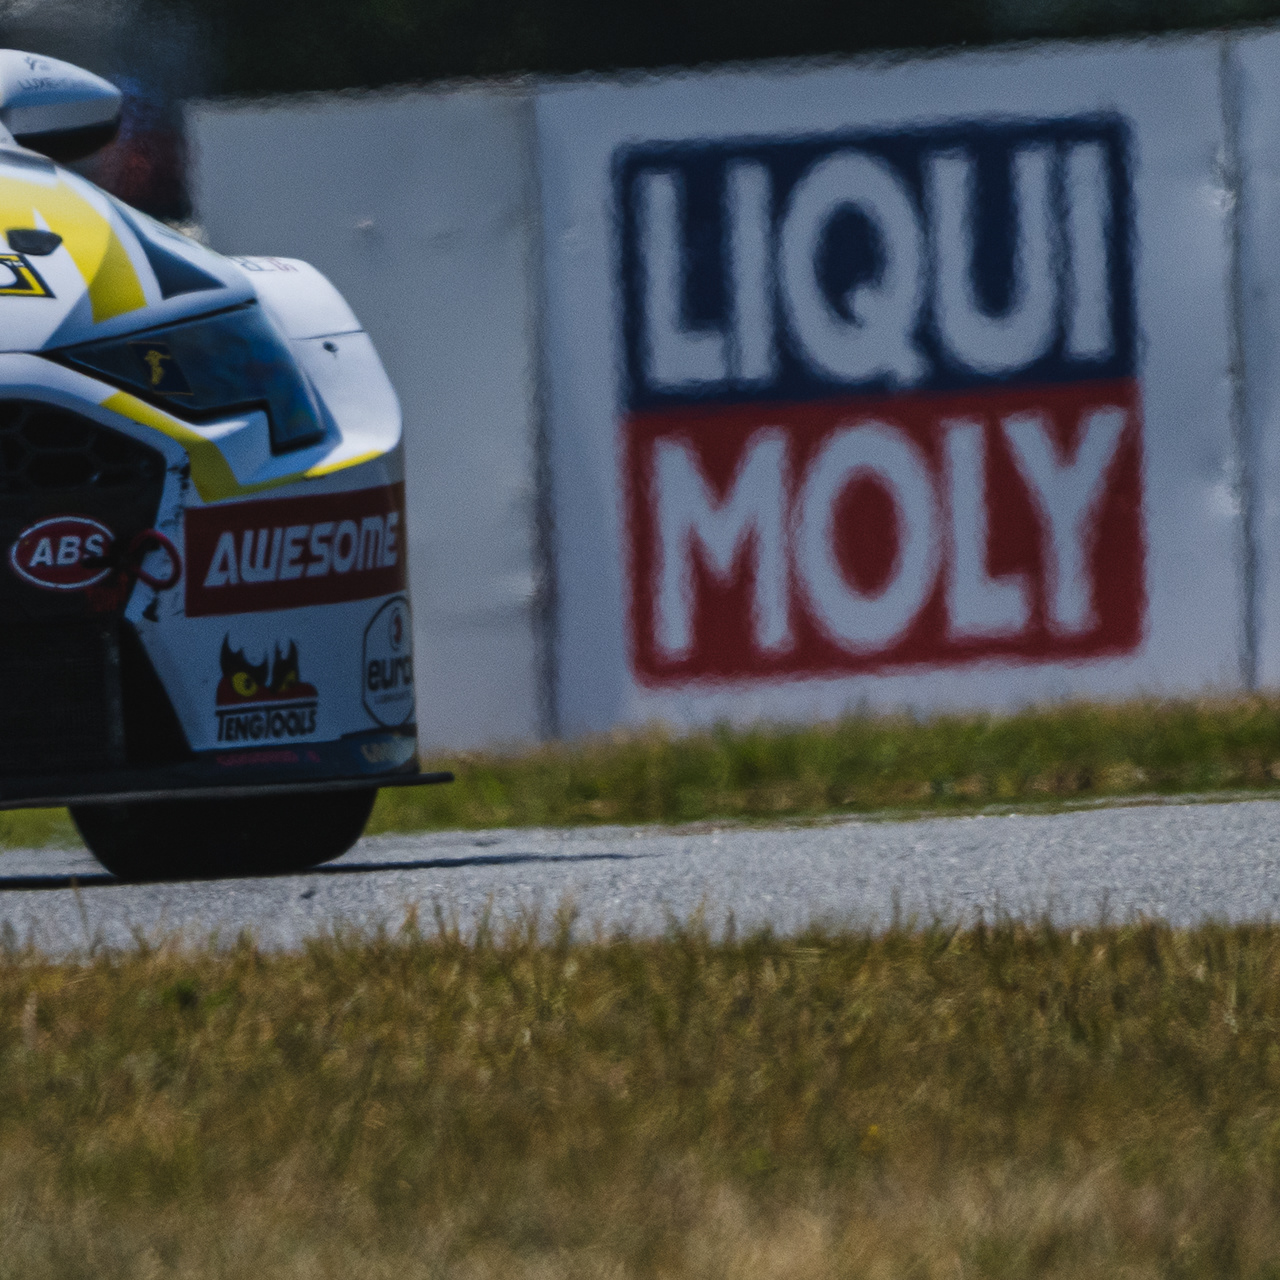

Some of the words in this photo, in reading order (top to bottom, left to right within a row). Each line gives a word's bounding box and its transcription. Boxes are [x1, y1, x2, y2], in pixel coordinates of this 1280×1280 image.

[643, 140, 1114, 387] LIQUI
[28, 533, 105, 568] ABS
[203, 511, 399, 588] AWESOME
[652, 404, 1130, 663] MOLY
